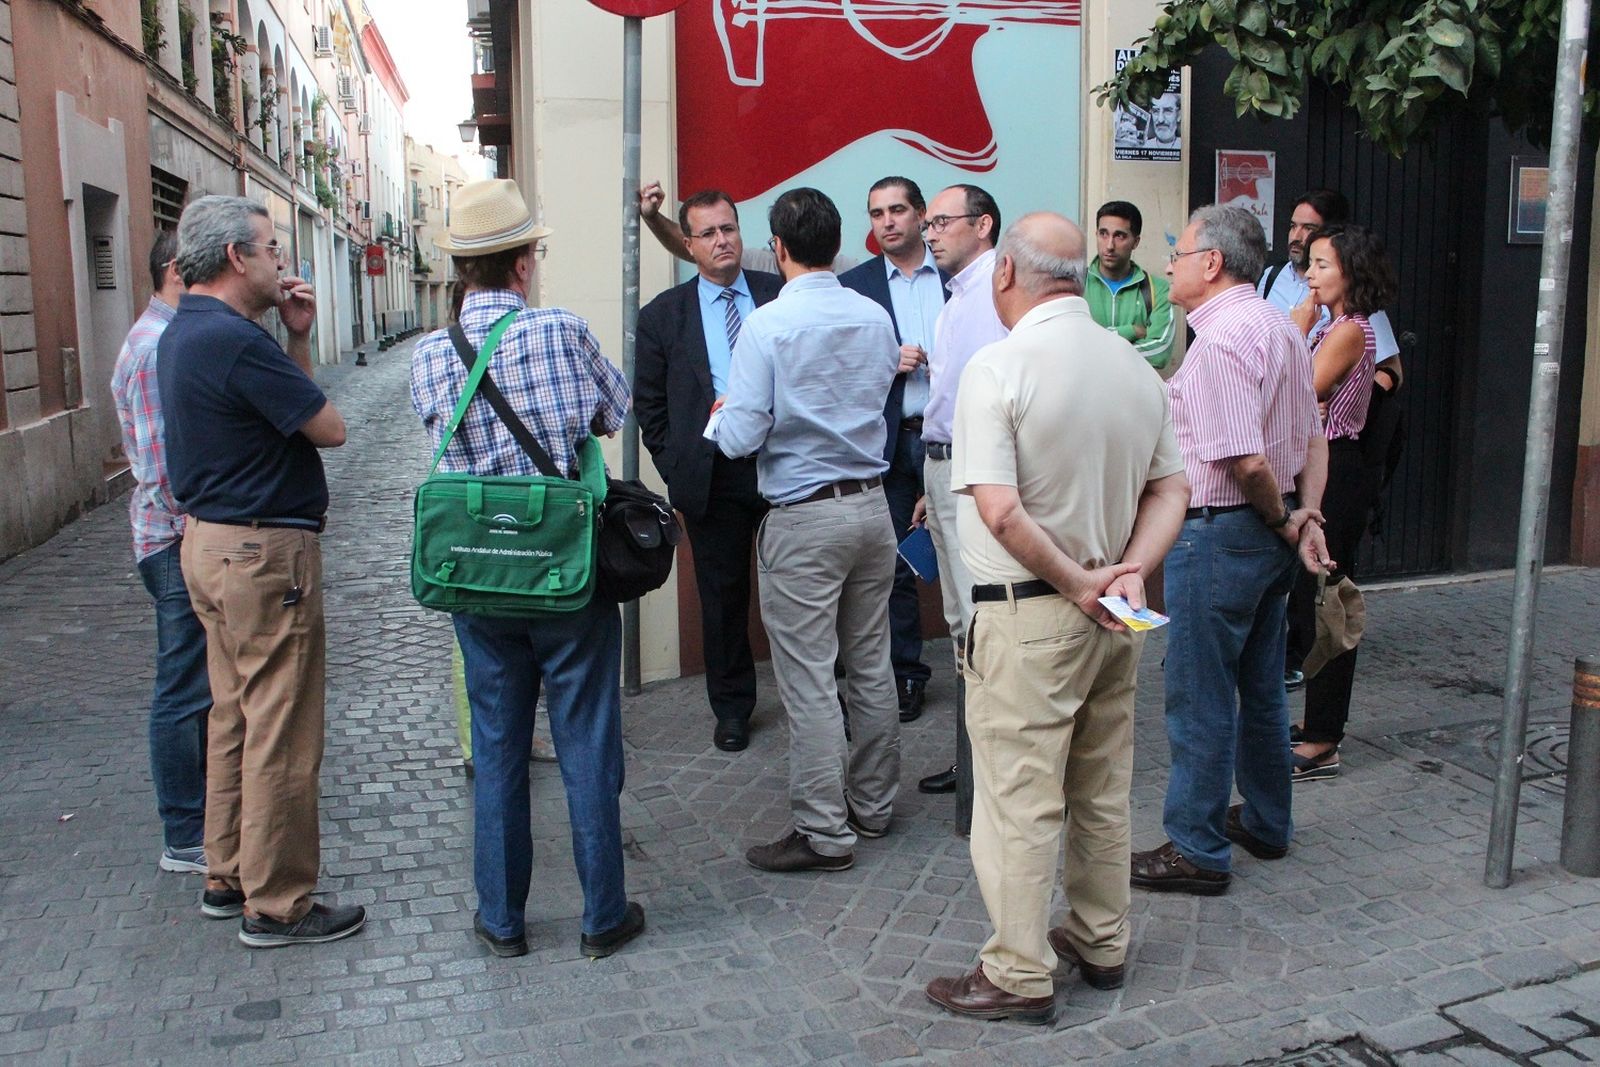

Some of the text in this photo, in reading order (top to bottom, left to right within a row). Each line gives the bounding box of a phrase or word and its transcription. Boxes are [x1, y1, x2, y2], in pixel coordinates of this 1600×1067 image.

[1251, 203, 1268, 216] Sala
[450, 545, 471, 553] Instituto
[499, 548, 534, 557] Administración
[535, 549, 553, 557] Pública
